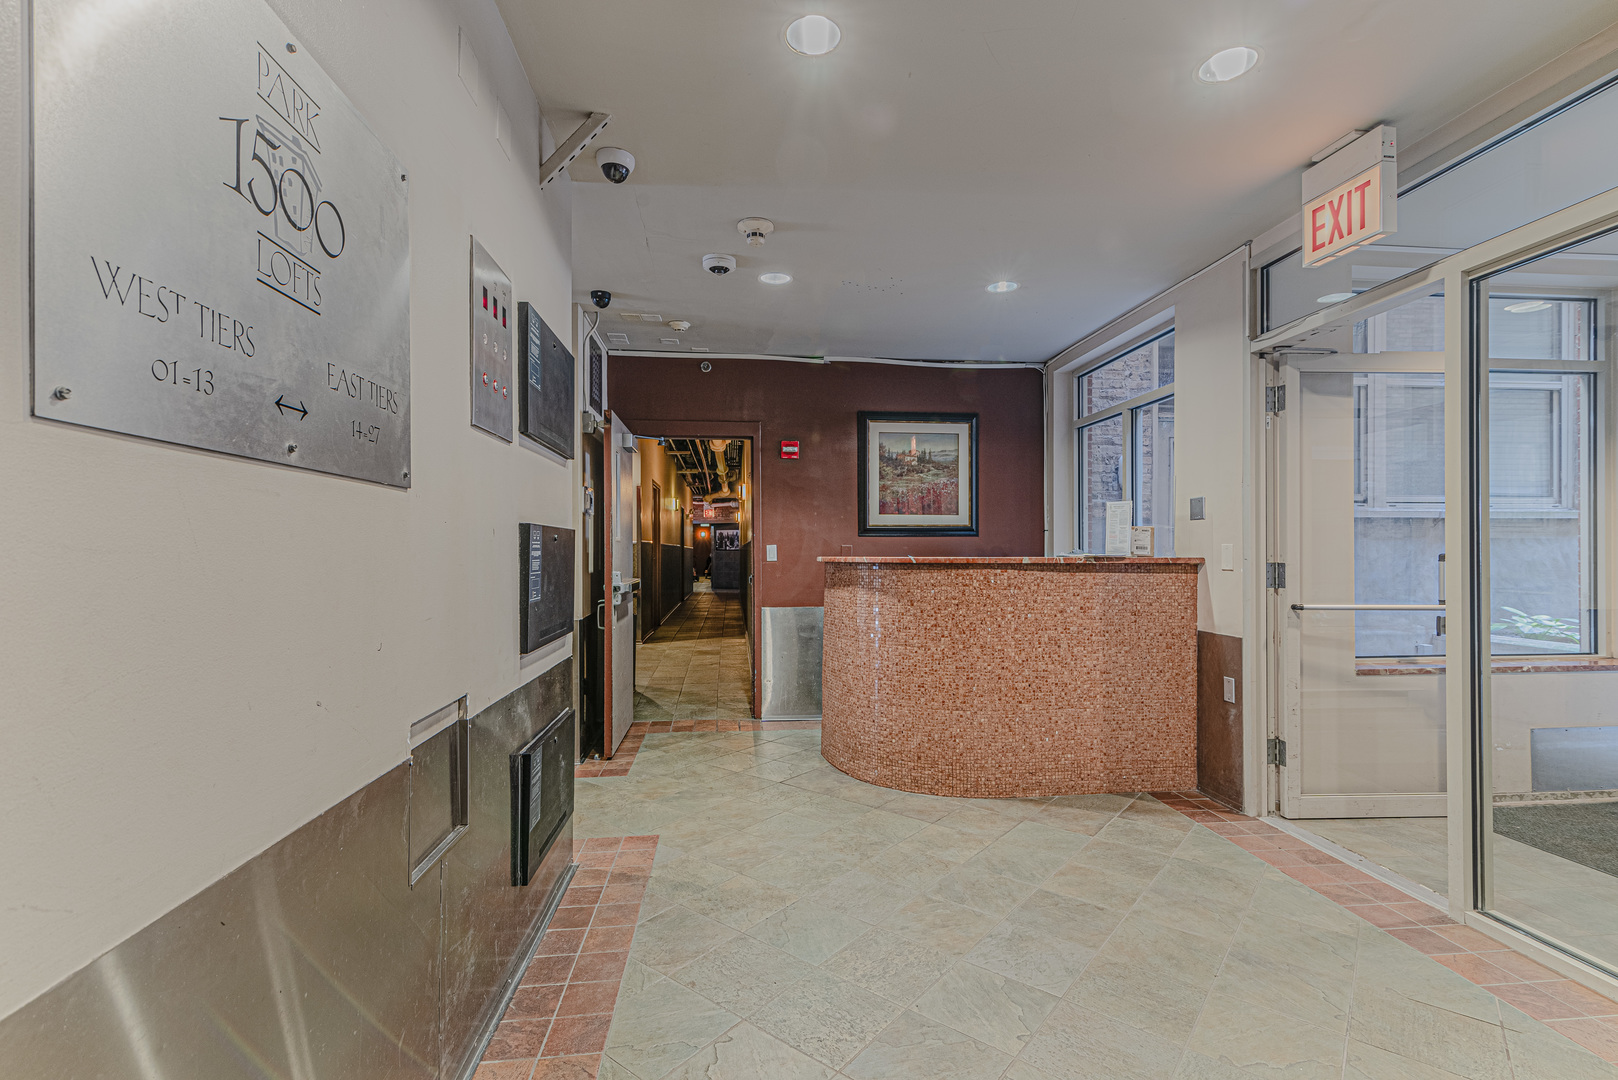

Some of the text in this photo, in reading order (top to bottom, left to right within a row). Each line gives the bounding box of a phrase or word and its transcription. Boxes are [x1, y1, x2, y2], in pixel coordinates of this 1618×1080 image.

[258, 51, 321, 149] PARK
[219, 116, 345, 259] 1500
[1311, 179, 1371, 253] EXIT
[91, 255, 256, 358] WEST TIERS
[257, 238, 322, 307] LOFTS
[327, 362, 399, 415] EAST TIERS
